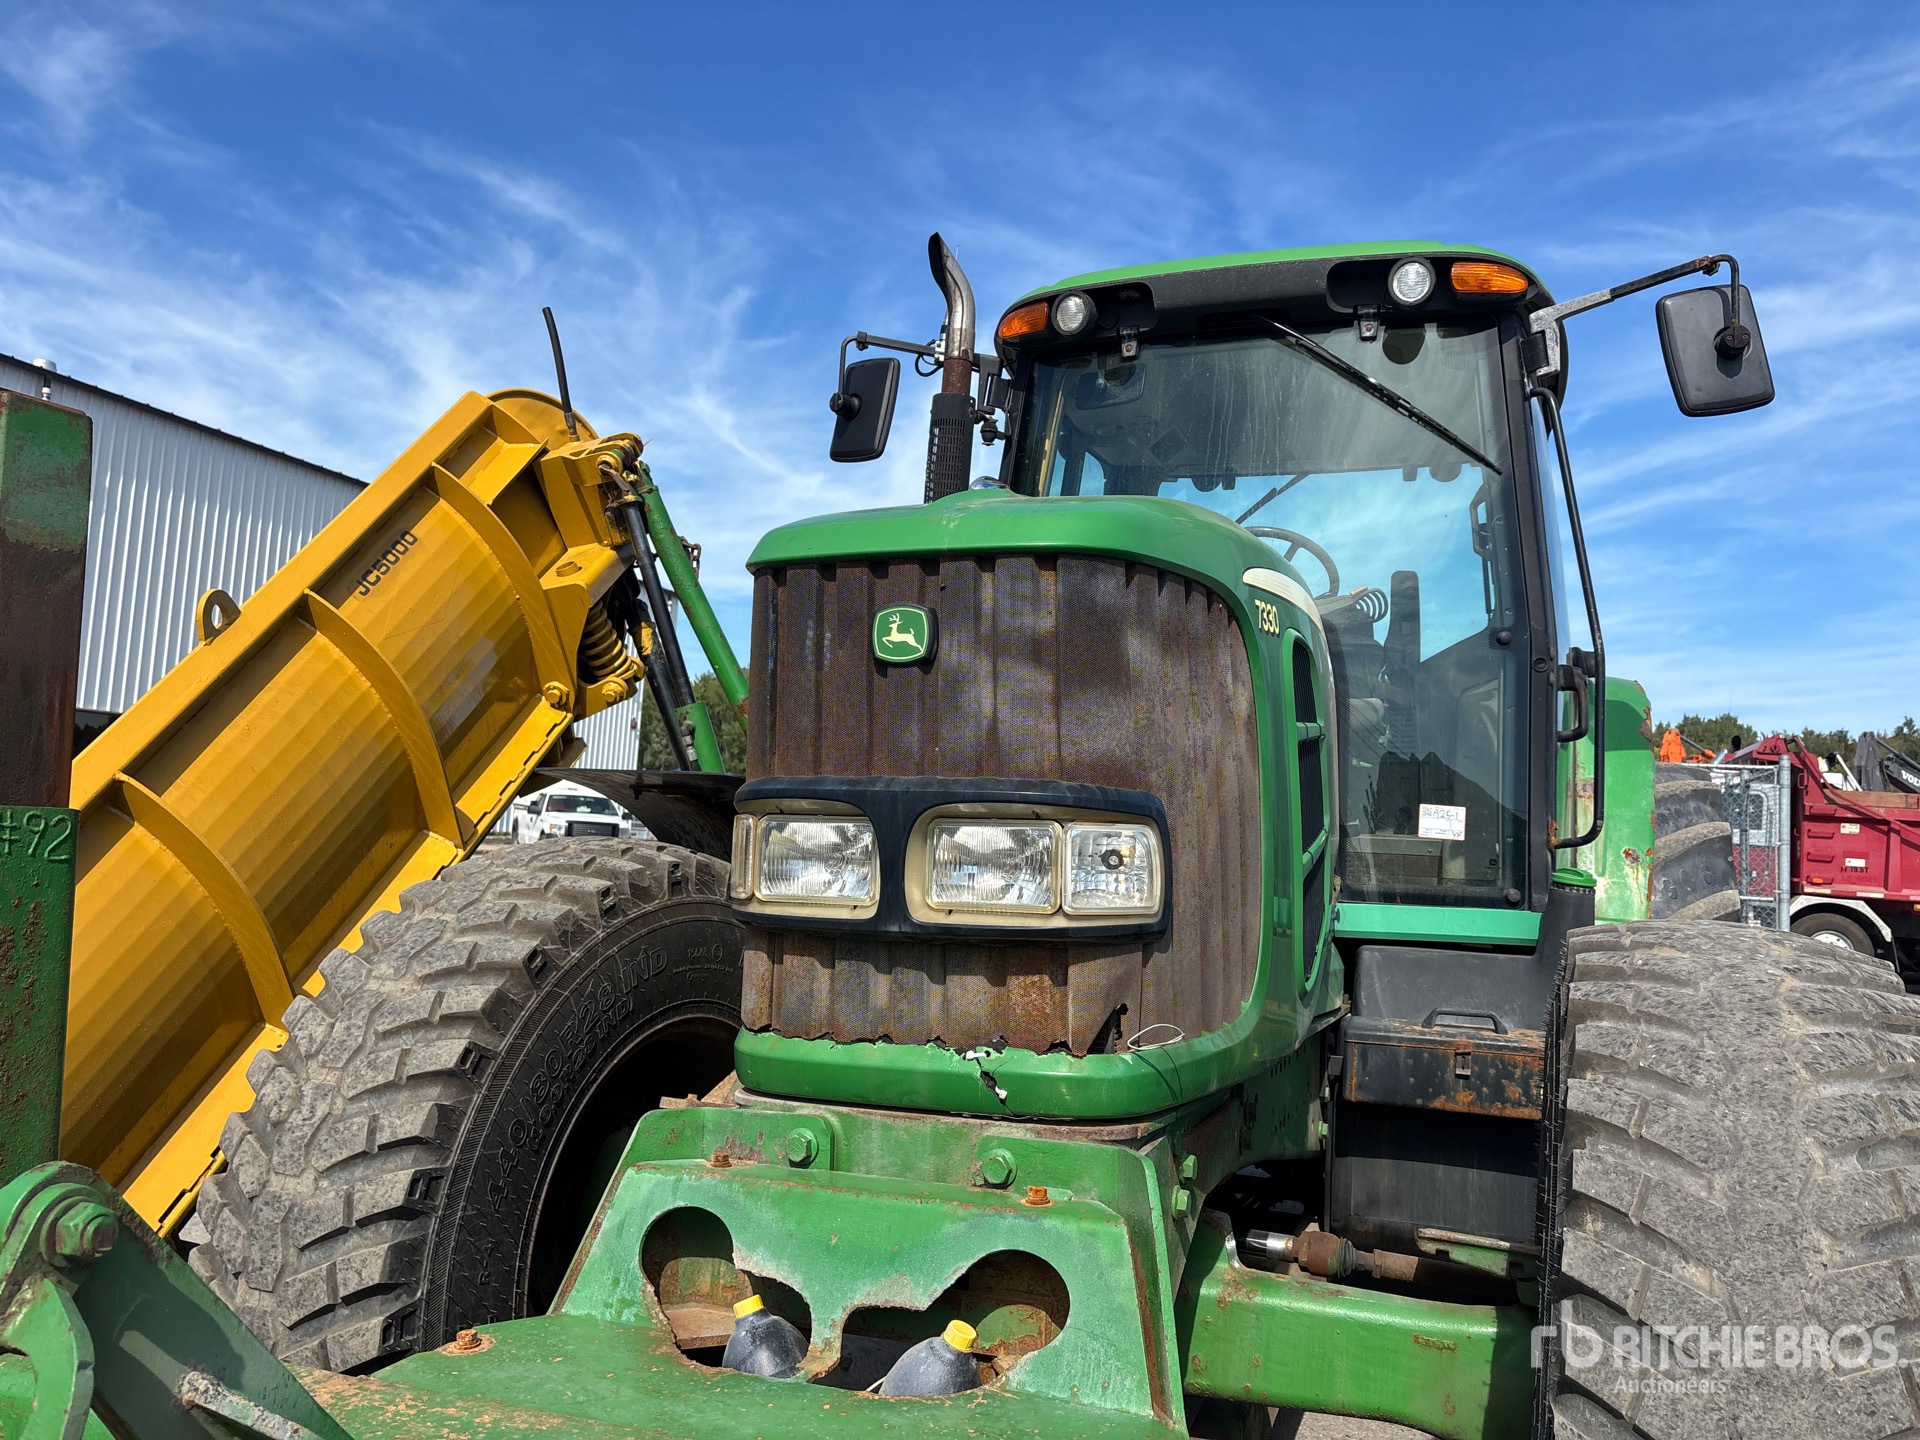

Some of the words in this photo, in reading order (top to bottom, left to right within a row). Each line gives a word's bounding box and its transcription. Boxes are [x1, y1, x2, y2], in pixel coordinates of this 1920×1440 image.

[356, 530, 419, 597] JC5000
[1254, 599, 1280, 636] 7330
[486, 981, 617, 1212] 440/80R28
[620, 947, 669, 994] IND
